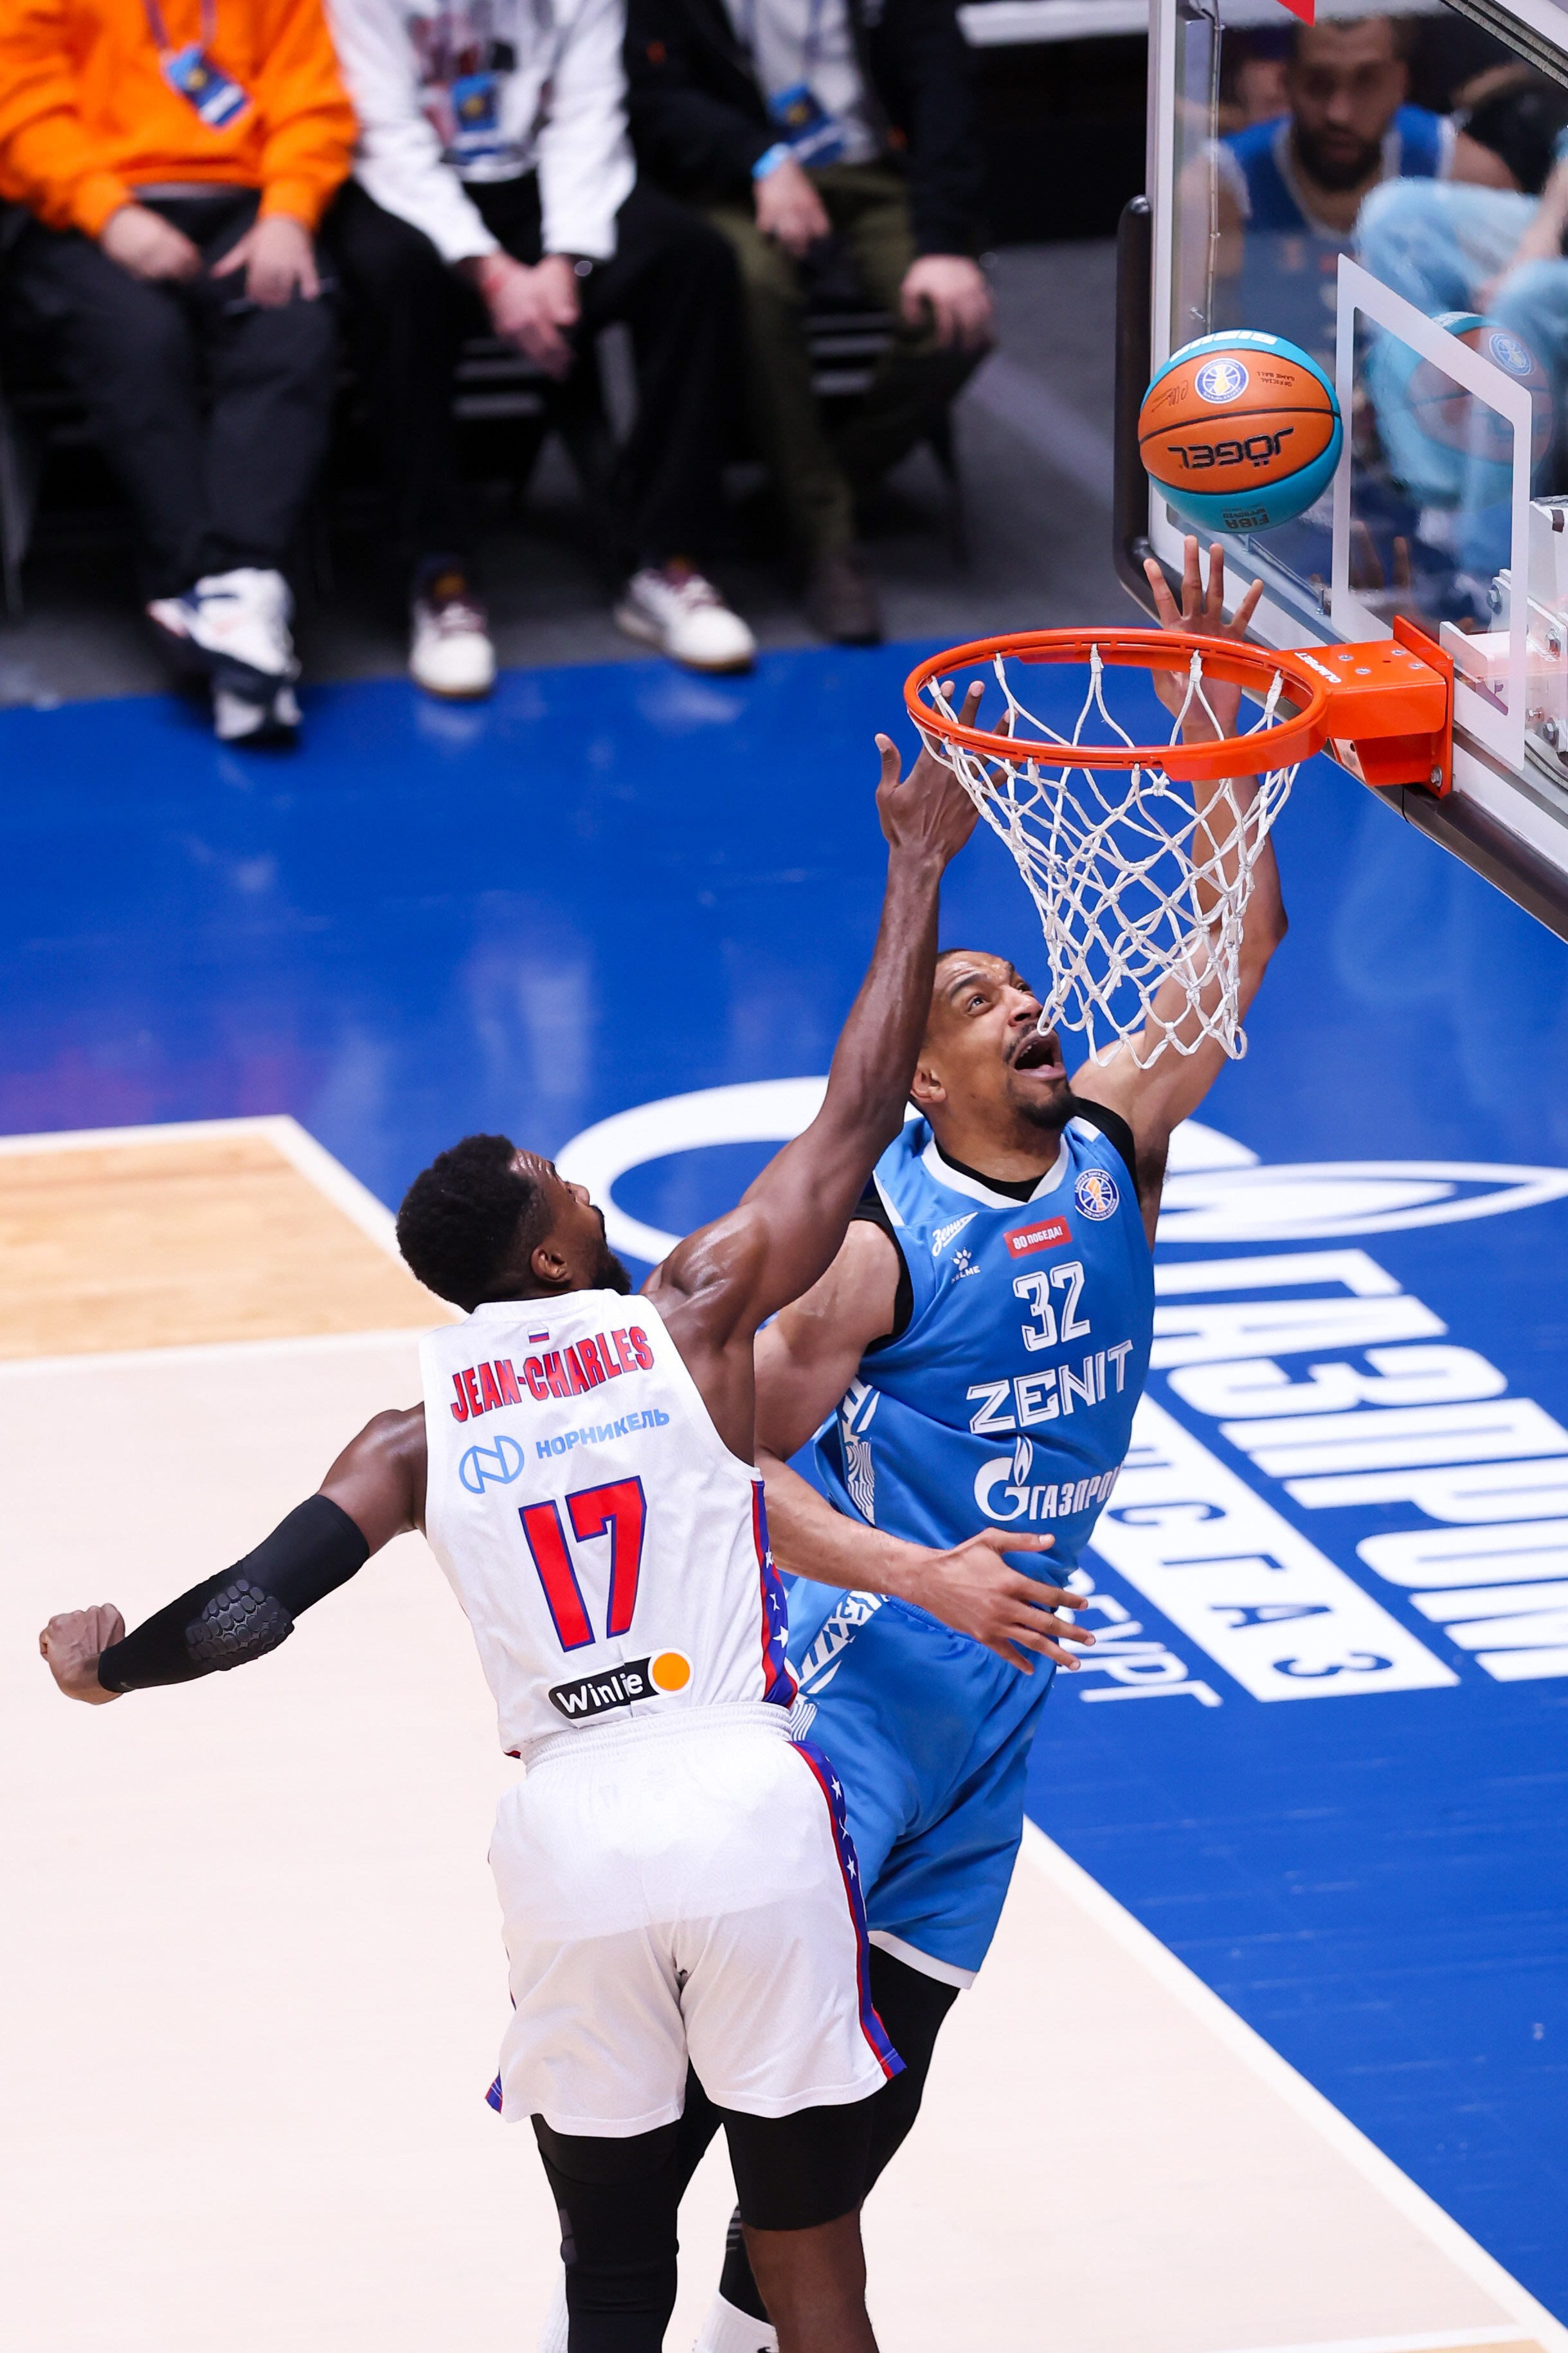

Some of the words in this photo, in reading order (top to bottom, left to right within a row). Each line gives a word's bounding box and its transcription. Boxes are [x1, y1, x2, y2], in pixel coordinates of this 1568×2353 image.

[1260, 377, 1292, 387] OFFICIAL
[1167, 426, 1294, 469] JÖGEL
[1224, 513, 1270, 529] FIBA
[1013, 1234, 1027, 1251] 80
[1027, 1224, 1063, 1246] ПОБЕДА!
[1013, 1260, 1090, 1352] 32
[450, 1325, 654, 1423] JEAN-CHARLES
[966, 1339, 1133, 1435] ZENIT
[536, 1408, 670, 1460] НОРНИКЕЛЬ
[518, 1475, 647, 1653] 17
